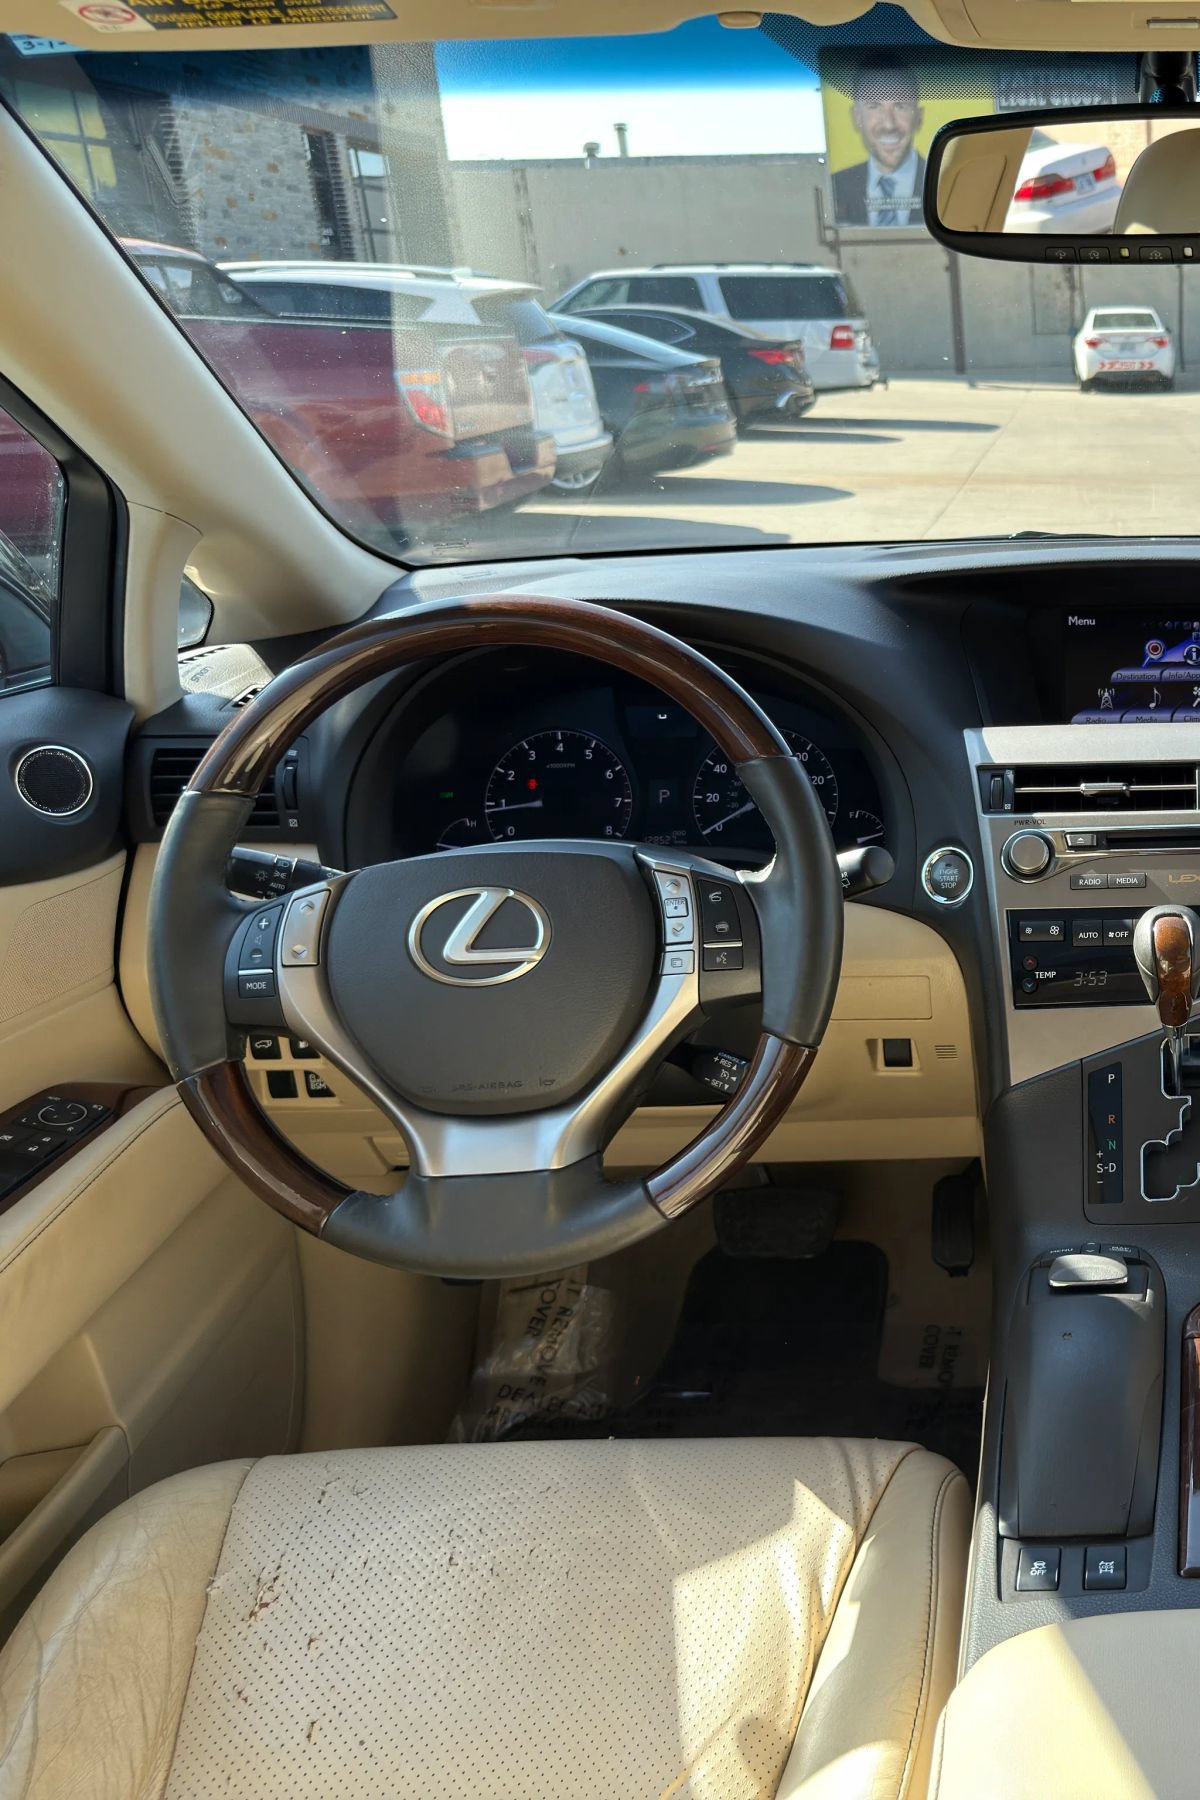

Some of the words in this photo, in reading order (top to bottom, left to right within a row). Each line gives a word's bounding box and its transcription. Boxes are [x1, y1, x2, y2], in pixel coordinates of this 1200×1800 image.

[1068, 615, 1096, 626] Menu
[1116, 672, 1157, 681] Destination
[555, 742, 564, 752] 4
[528, 750, 537, 760] 3
[584, 749, 593, 759] 5
[713, 764, 728, 774] 40
[507, 770, 516, 781] 2
[605, 769, 614, 780] 6
[658, 788, 670, 804] P
[706, 793, 720, 803] 20
[615, 797, 622, 807] 7
[507, 826, 515, 836] 0
[605, 825, 613, 835] 8
[1079, 878, 1102, 886] RADIO
[1116, 877, 1139, 885] MEDIA
[666, 898, 686, 906] ENTER
[1078, 931, 1099, 939] AUTO
[1034, 971, 1057, 979] TEMP
[1073, 970, 1108, 987] 3:53
[246, 981, 267, 990] MODE
[719, 1058, 732, 1068] RES
[710, 1078, 724, 1088] SET
[1107, 1073, 1116, 1084] P
[1107, 1114, 1116, 1125] R
[1107, 1139, 1117, 1150] N
[1029, 1567, 1047, 1578] OFF
